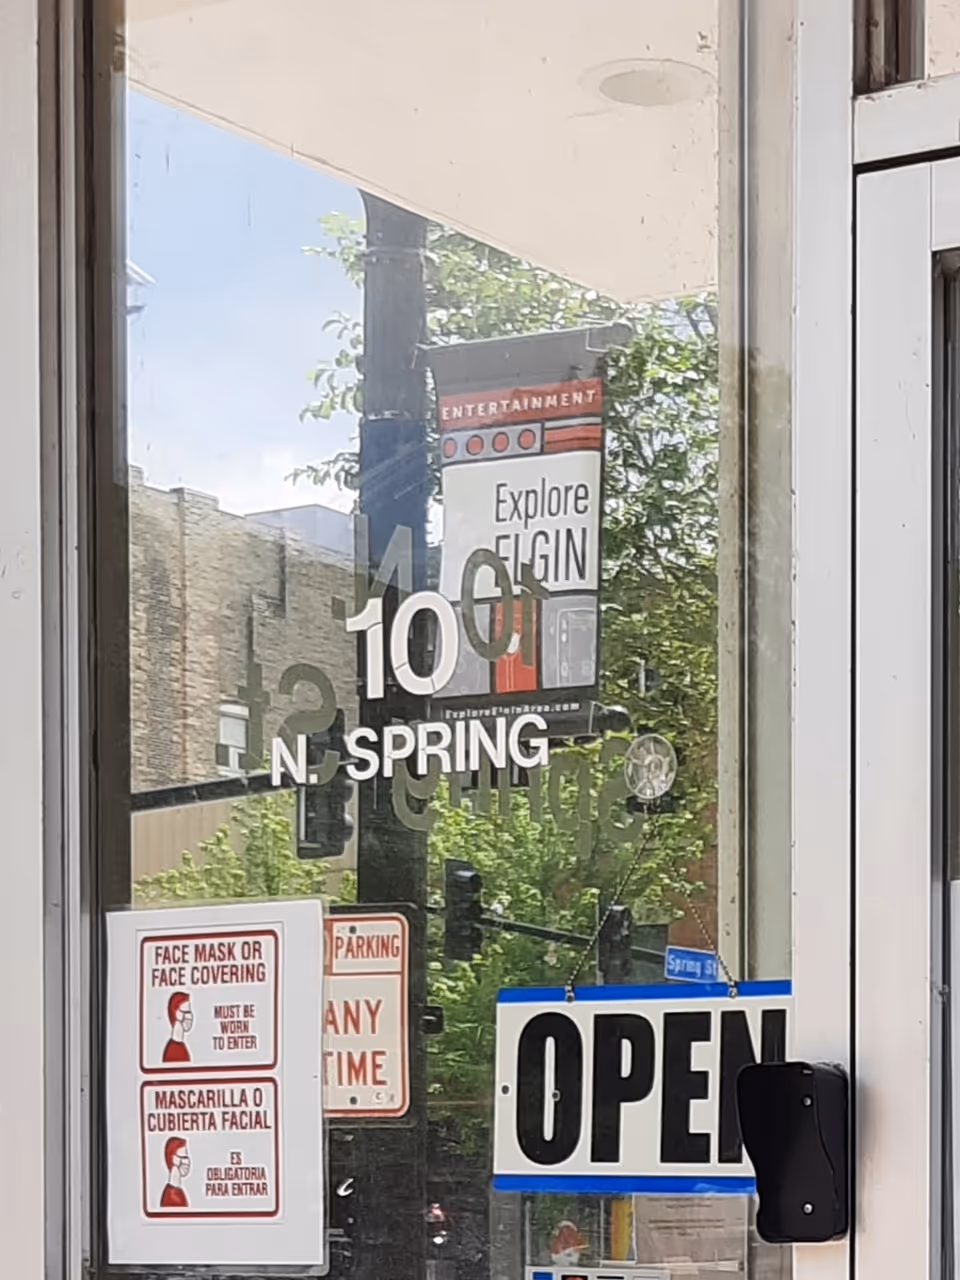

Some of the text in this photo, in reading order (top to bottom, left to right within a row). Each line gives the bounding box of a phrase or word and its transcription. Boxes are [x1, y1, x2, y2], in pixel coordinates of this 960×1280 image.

[441, 389, 597, 421] ENTERTAINMENT
[495, 477, 589, 530] Explore
[494, 527, 587, 586] ELGIN
[344, 590, 460, 700] 10
[271, 712, 550, 786] N. SPRING
[155, 941, 262, 964] FACE MASK OR
[335, 935, 400, 959] PARKING
[152, 963, 266, 987] FACE COVERING
[668, 954, 718, 979] Spring St
[214, 1005, 255, 1020] MUST BE
[323, 1000, 383, 1036] ANY
[220, 1021, 249, 1034] WORN
[213, 1036, 257, 1050] TO ENTER
[323, 1051, 388, 1087] TIME
[155, 1088, 263, 1109] MASCARILLA O
[516, 1008, 788, 1166] OPEN
[148, 1111, 272, 1132] CUBIERTA FACIAL
[230, 1152, 242, 1165] ES
[207, 1167, 266, 1181] OBLIGATORIA
[205, 1183, 268, 1197] PARA ENTRAR
